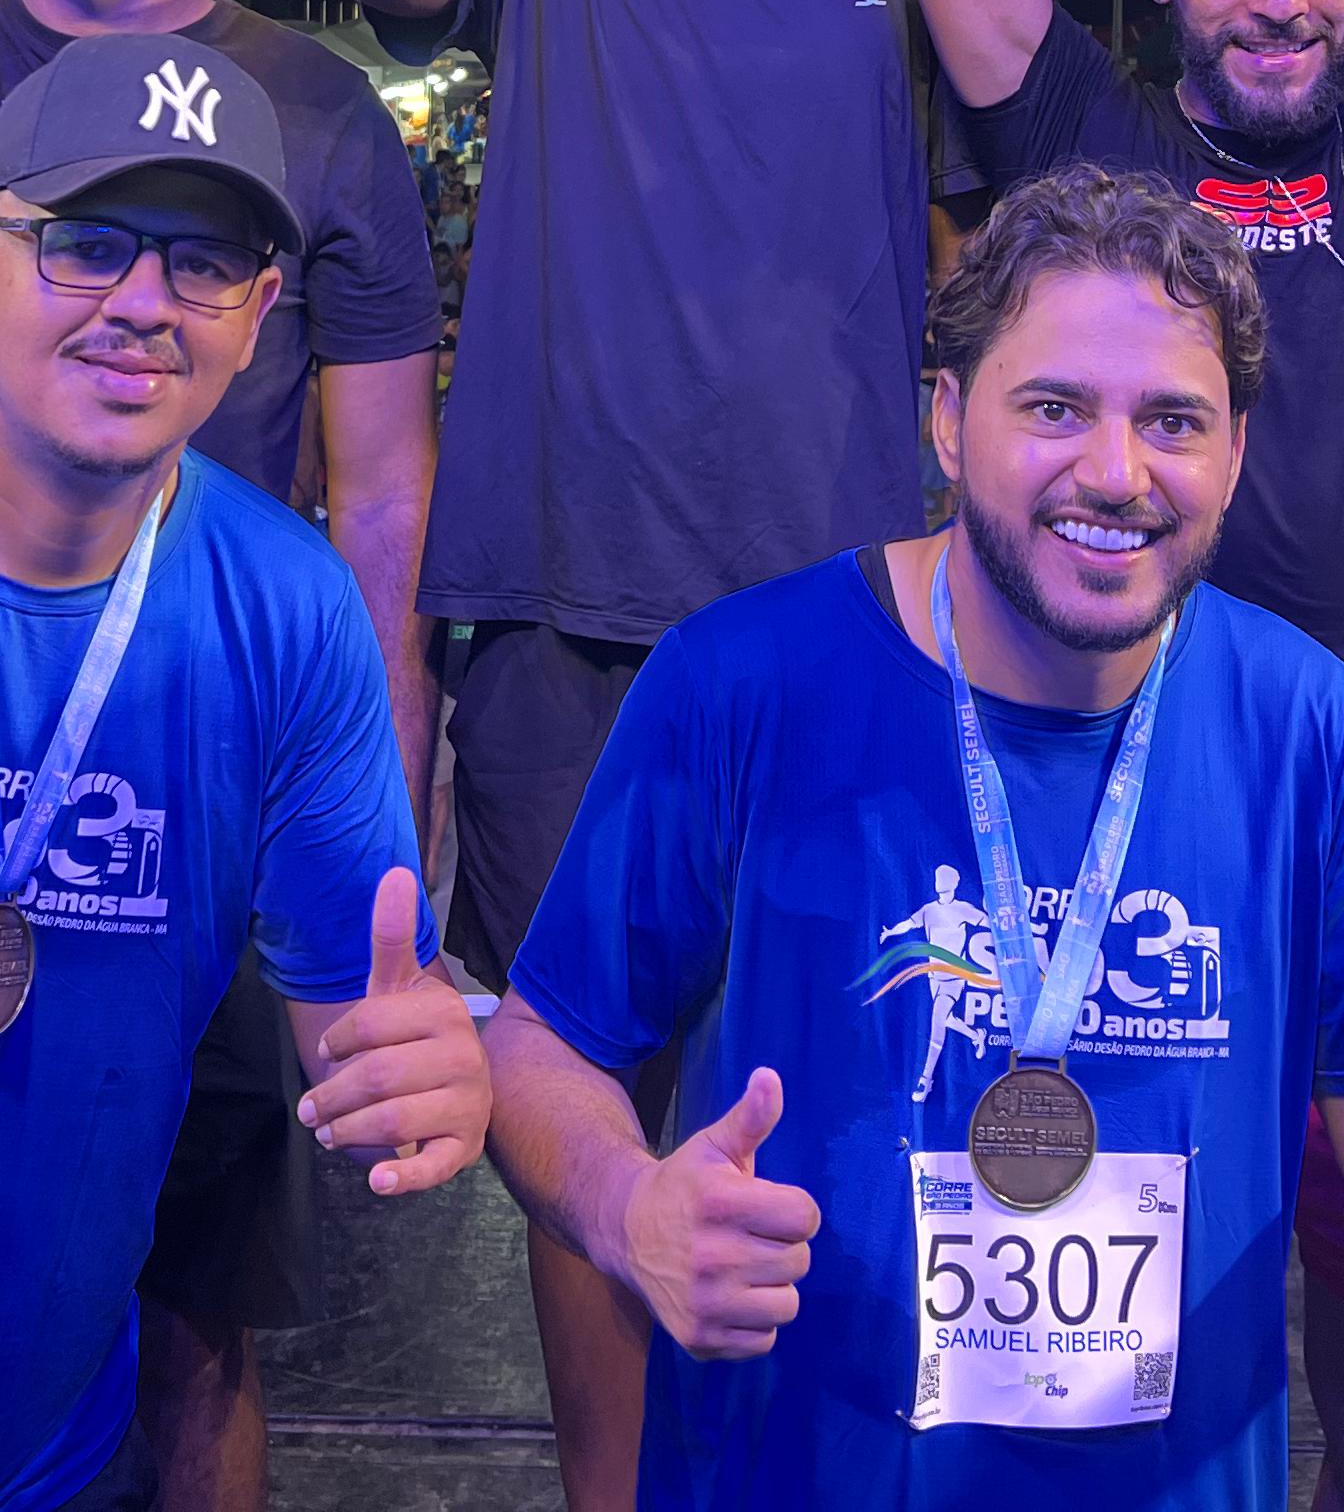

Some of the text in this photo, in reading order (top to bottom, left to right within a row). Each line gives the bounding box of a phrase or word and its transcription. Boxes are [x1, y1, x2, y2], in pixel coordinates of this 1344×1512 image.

[138, 58, 222, 147] NY
[962, 698, 992, 834] SECULT SEMEL
[36, 890, 119, 916] anos
[54, 917, 84, 930] PEDRO
[84, 920, 96, 930] DA
[96, 918, 118, 932] ÁGUA
[119, 922, 150, 934] BRANCA
[1103, 1014, 1184, 1040] anos
[1124, 1044, 1152, 1057] PEDRO
[1153, 1047, 1166, 1057] DA
[1166, 1044, 1187, 1058] ÁGUA
[1188, 1047, 1214, 1058] BRANCA
[1020, 1092, 1079, 1106] SÃO PEDRO
[976, 1126, 1088, 1145] SECULT SEMEL
[926, 1182, 973, 1192] CORRE
[924, 1234, 1159, 1326] 5307
[935, 1328, 1143, 1353] SAMUEL RIBEIRO
[1046, 1385, 1068, 1399] Chip
